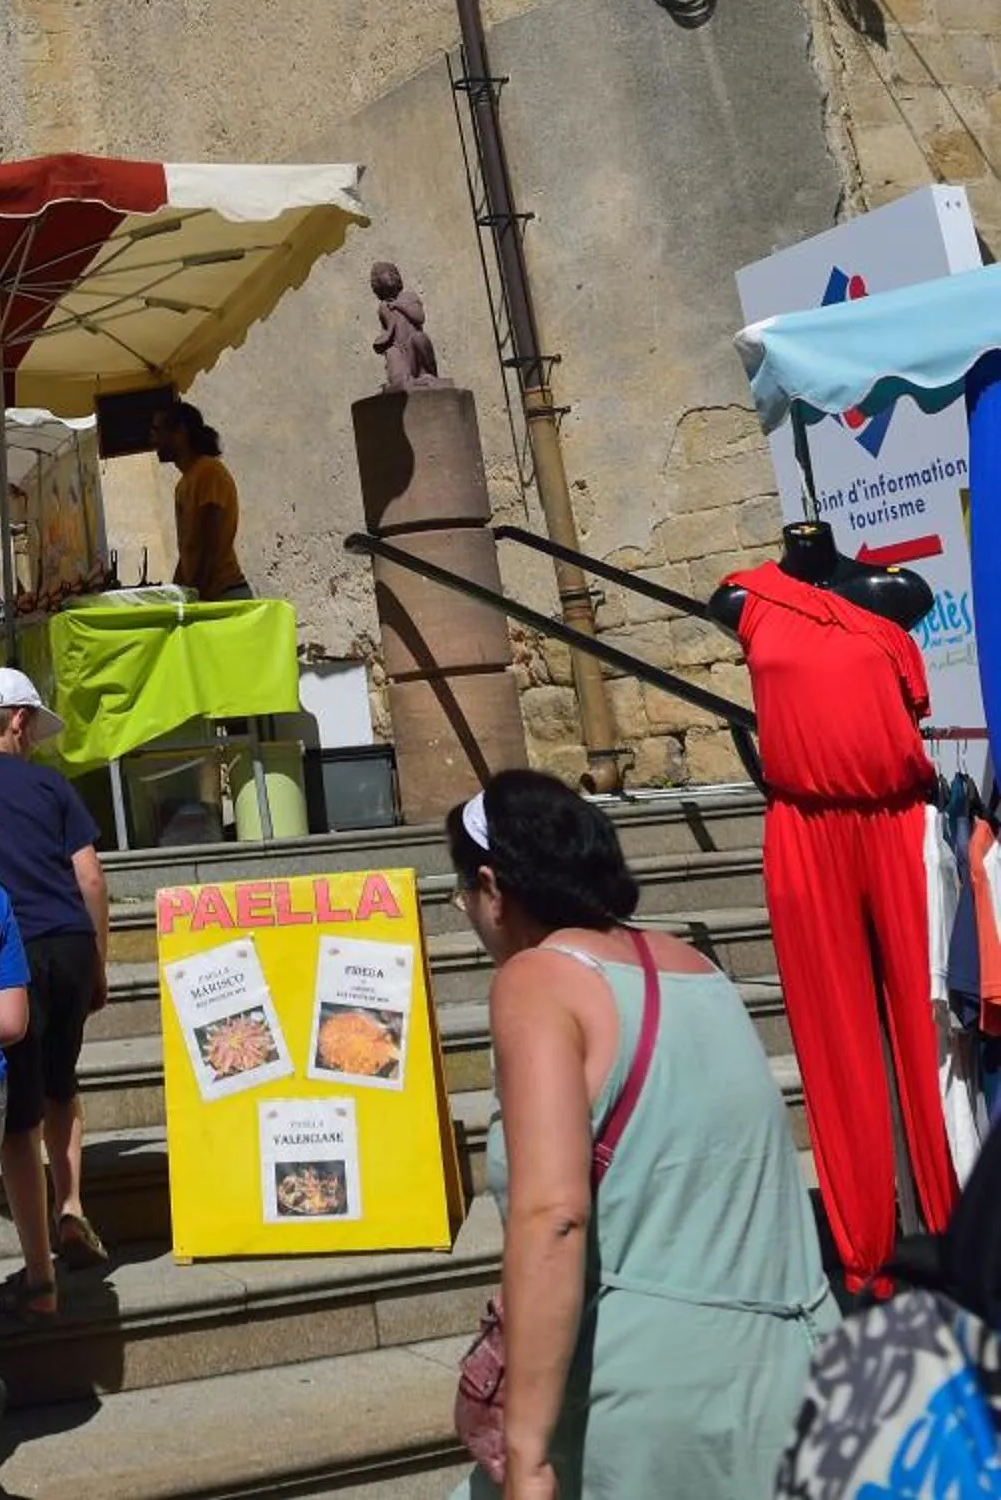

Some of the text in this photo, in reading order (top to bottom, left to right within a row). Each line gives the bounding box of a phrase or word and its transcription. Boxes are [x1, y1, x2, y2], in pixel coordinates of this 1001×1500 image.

[848, 456, 968, 504] d'information
[849, 497, 926, 530] tourisme
[157, 873, 402, 934] PAELLA
